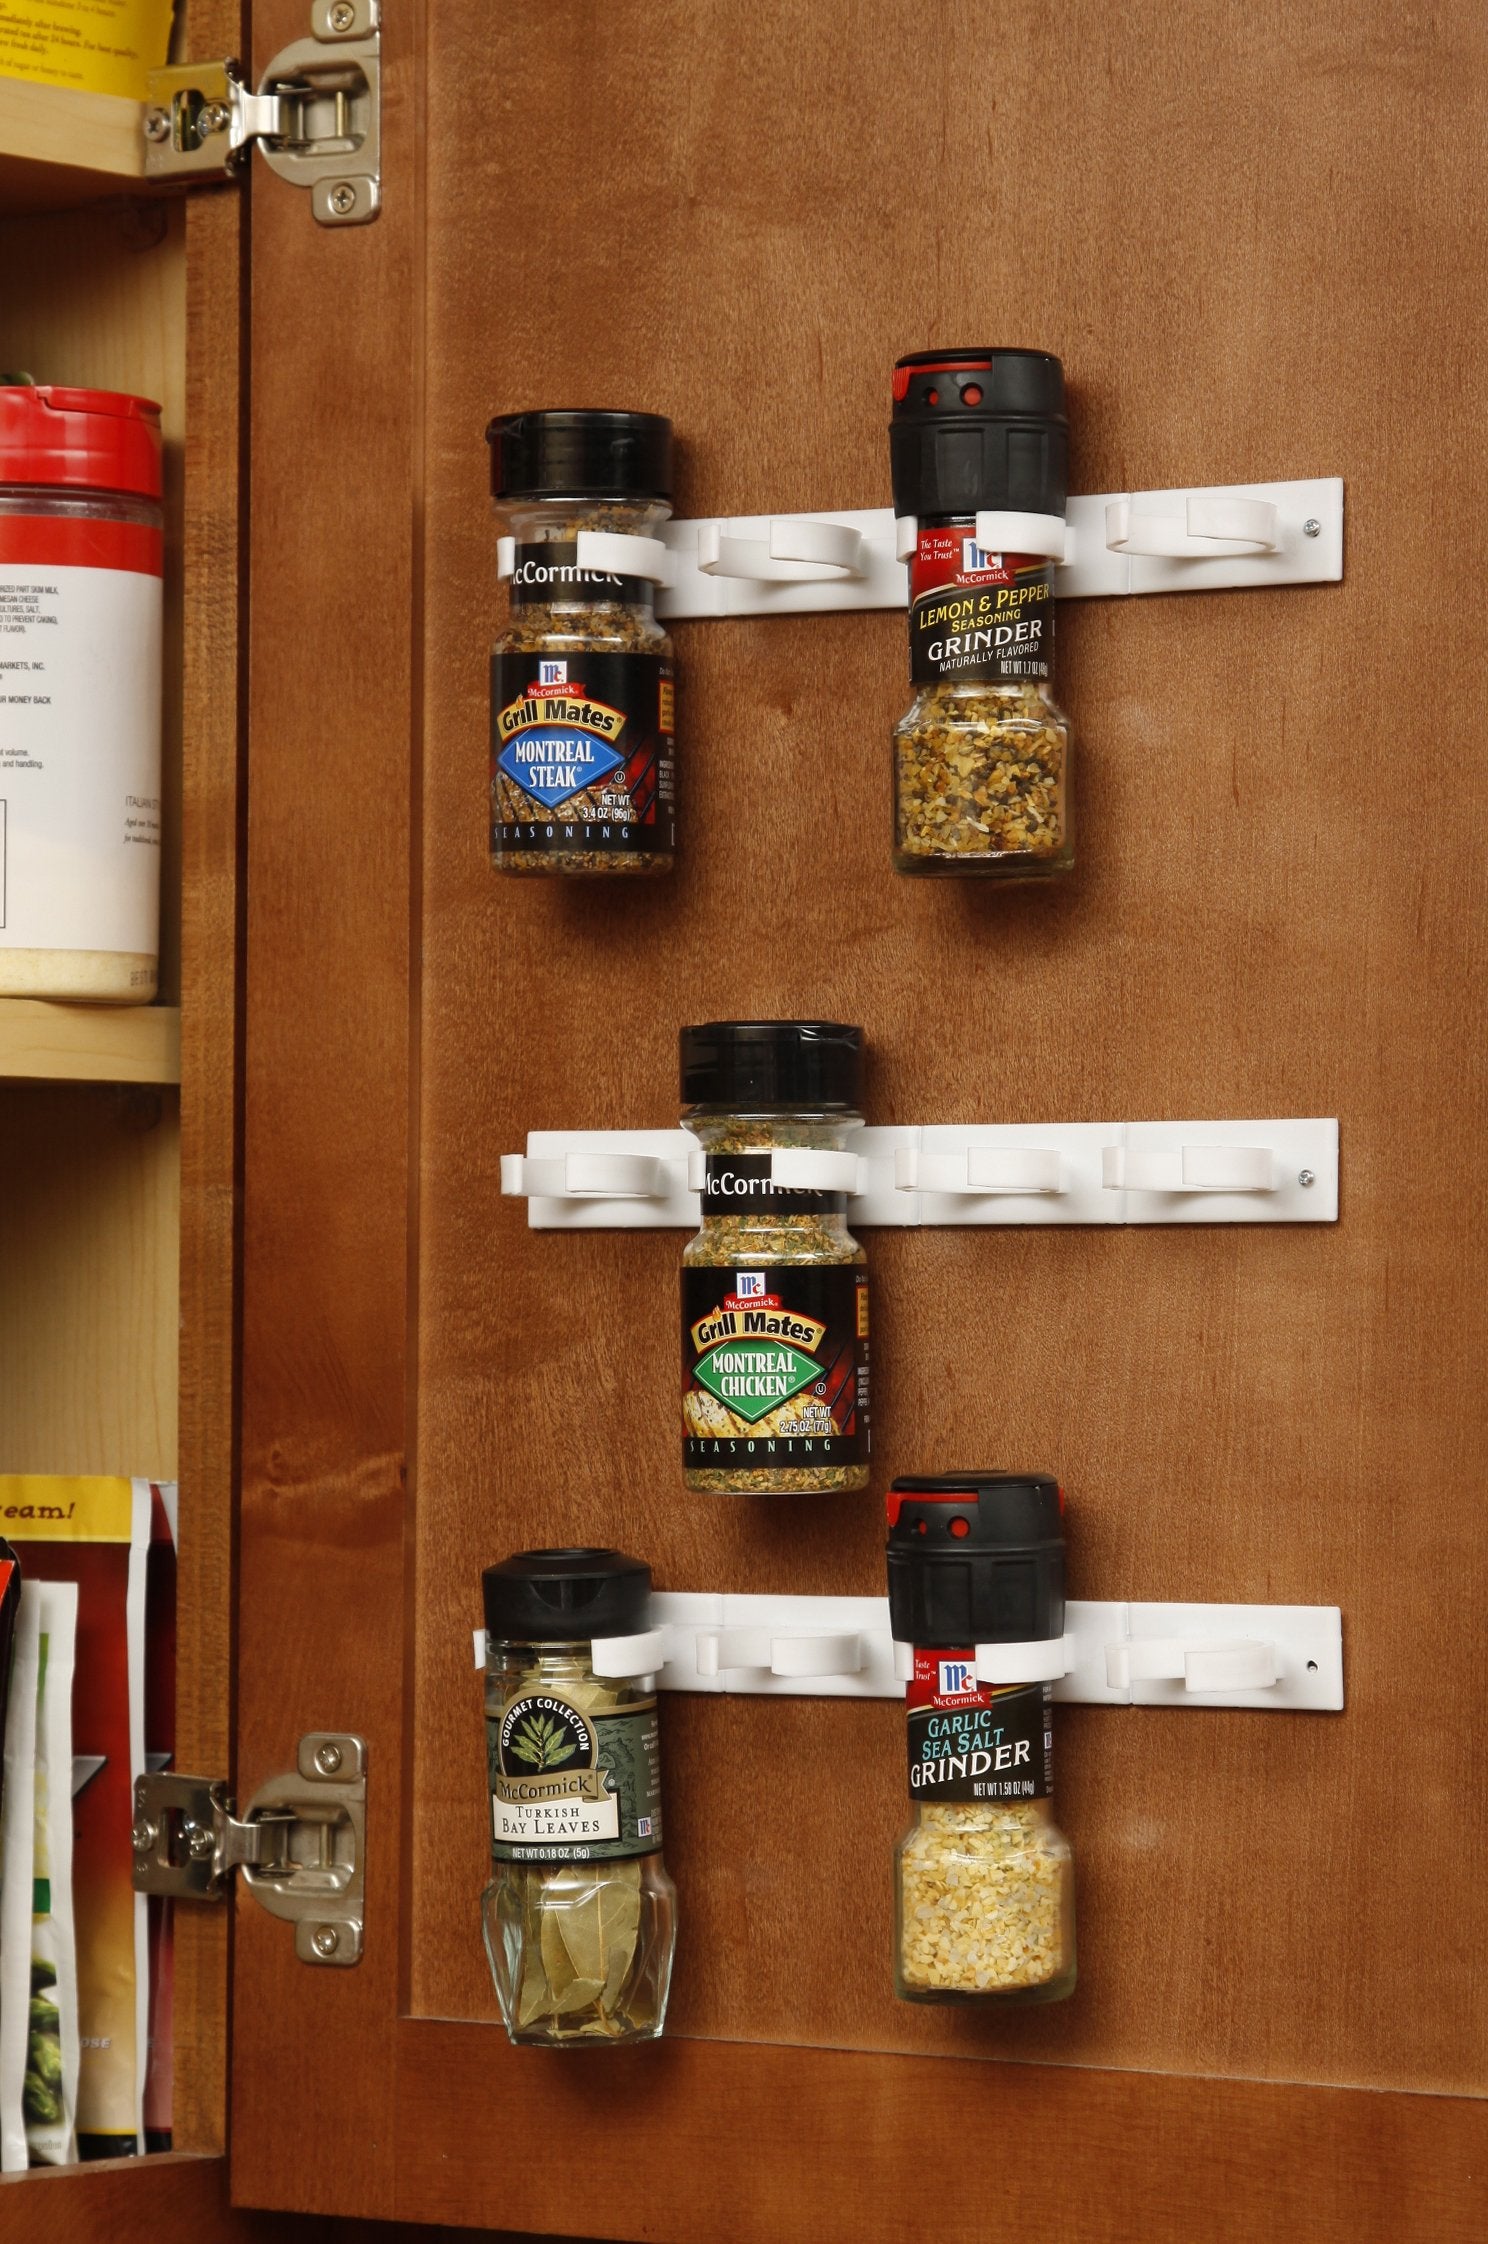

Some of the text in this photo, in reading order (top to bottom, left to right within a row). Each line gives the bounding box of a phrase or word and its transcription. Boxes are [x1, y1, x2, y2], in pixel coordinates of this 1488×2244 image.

[920, 538, 953, 549] The Taste
[919, 551, 932, 562] You
[955, 570, 1009, 585] McCormick
[919, 583, 1050, 630] LEMON & PEPPER
[951, 608, 1022, 633] SEASONING
[927, 619, 1043, 662] GRINDER
[939, 641, 1039, 673] NATURALLY FLAVORED
[1000, 660, 1012, 675] NET
[1012, 660, 1022, 675] WT
[501, 698, 538, 732] Grill
[515, 740, 594, 764] MONTREAL
[601, 794, 630, 806] NET WT
[583, 806, 596, 819] 3.4
[597, 807, 609, 819] OZ
[494, 825, 630, 840] SEASONING
[725, 1298, 774, 1310] McCormick
[697, 1312, 737, 1344] Grill
[712, 1352, 797, 1374] MONTREAL
[803, 1406, 832, 1418] NET WT
[780, 1420, 798, 1432] 2.75
[799, 1420, 810, 1432] OZ
[690, 1438, 832, 1453] SEASONING
[0, 1502, 76, 1520] eam!
[914, 1658, 931, 1670] Taste
[933, 1693, 985, 1707] McCormick
[502, 1698, 590, 1751] GOURMET COLLECTION
[928, 1709, 992, 1738] GARLIC
[922, 1728, 1005, 1761] SEA SALT
[910, 1739, 1031, 1788] GRINDER
[500, 1775, 592, 1800] McCormick
[973, 1782, 986, 1796] NET
[987, 1782, 997, 1796] WT
[1013, 1781, 1021, 1795] OZ
[515, 1805, 580, 1819] TURKISH
[502, 1818, 600, 1834] BAY LEAVES
[512, 1846, 590, 1860] NET WT 0.18 OZ (5g)
